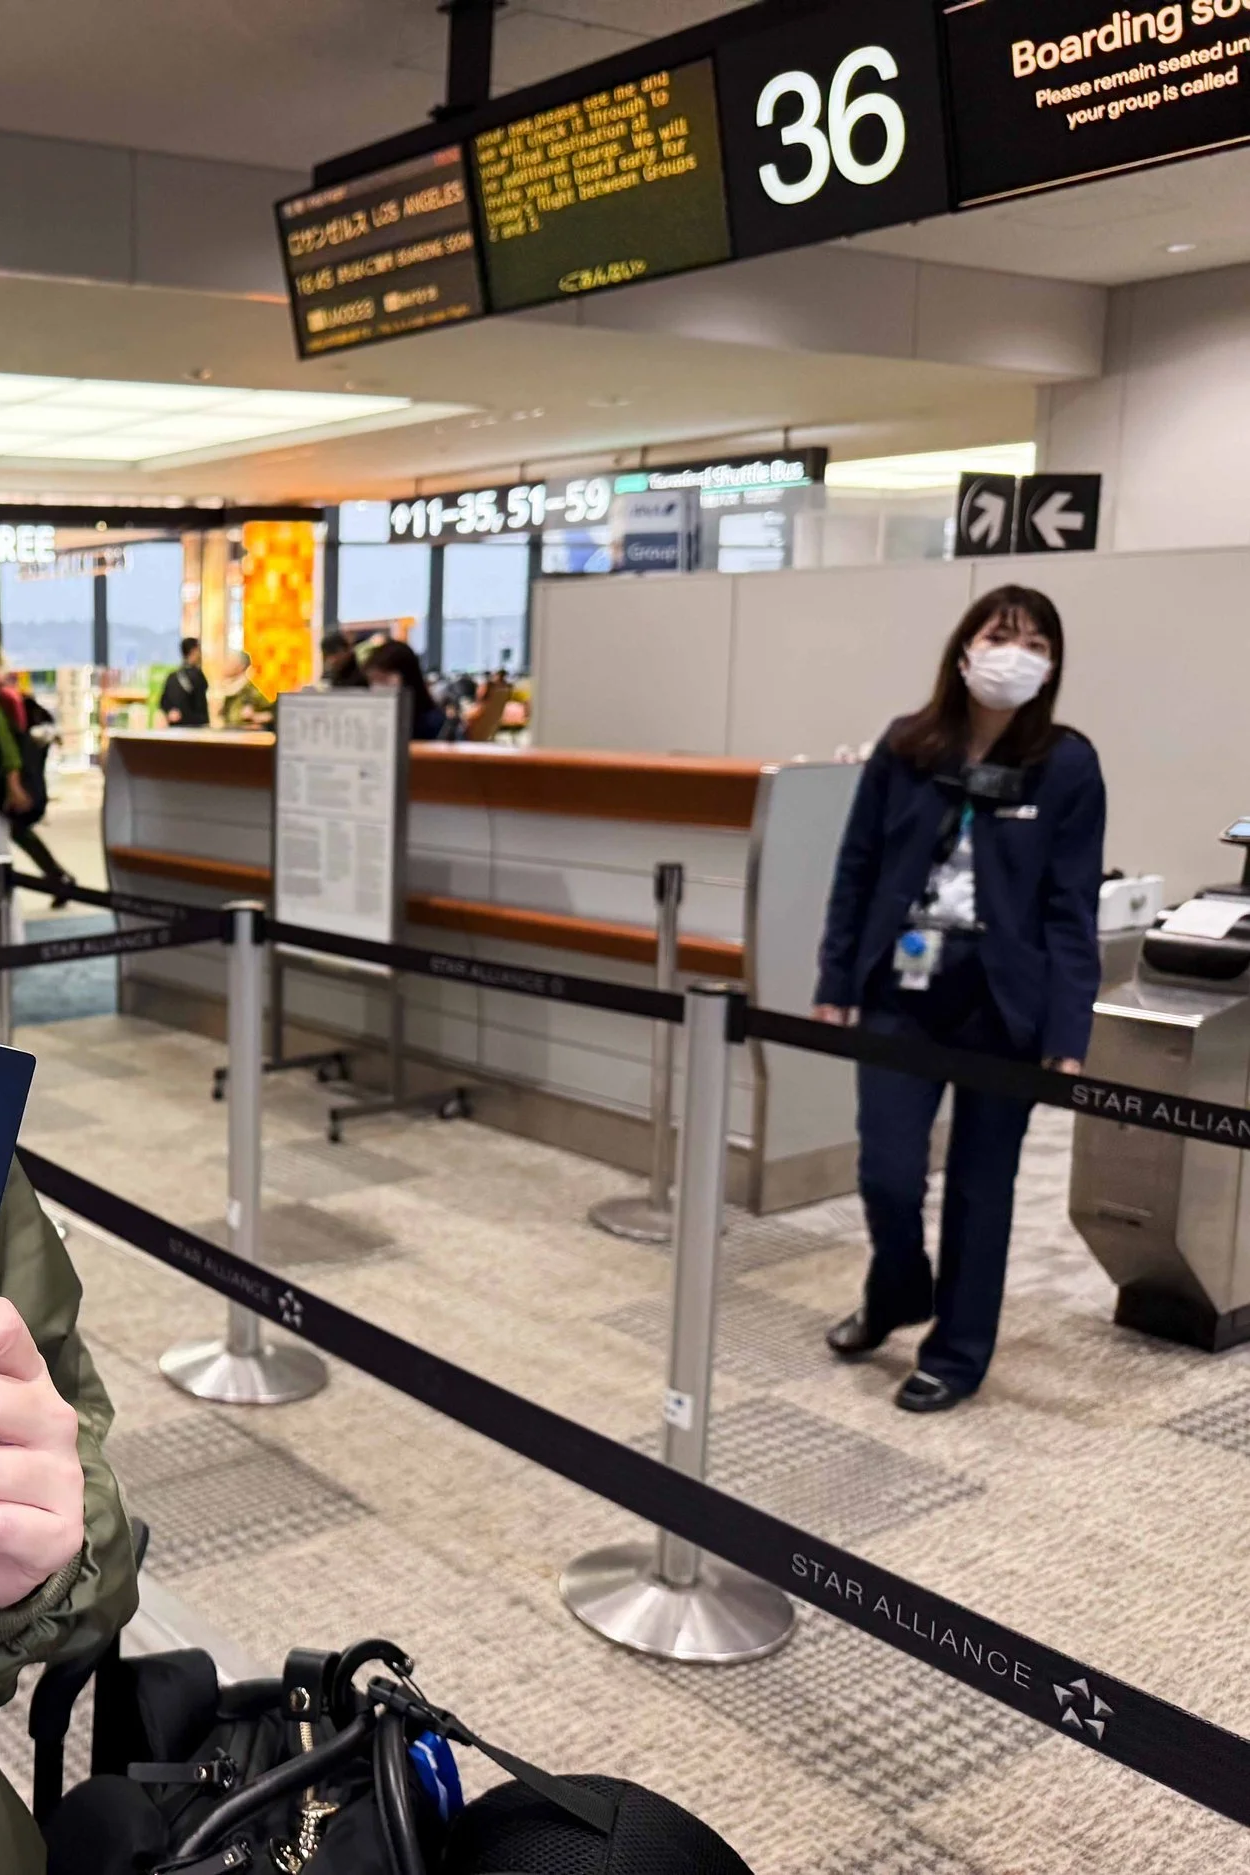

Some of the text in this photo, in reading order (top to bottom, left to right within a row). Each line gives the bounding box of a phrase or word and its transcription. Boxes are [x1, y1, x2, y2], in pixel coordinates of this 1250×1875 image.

[1011, 4, 1183, 78] Boarding
[1036, 81, 1092, 108] Please
[1094, 62, 1156, 92] remain
[1158, 40, 1223, 75] seated
[756, 46, 905, 204] 36
[1066, 65, 1238, 131] your group is called
[1071, 1084, 1143, 1116] STAR
[791, 1553, 1032, 1690] STAR ALLIANCE
